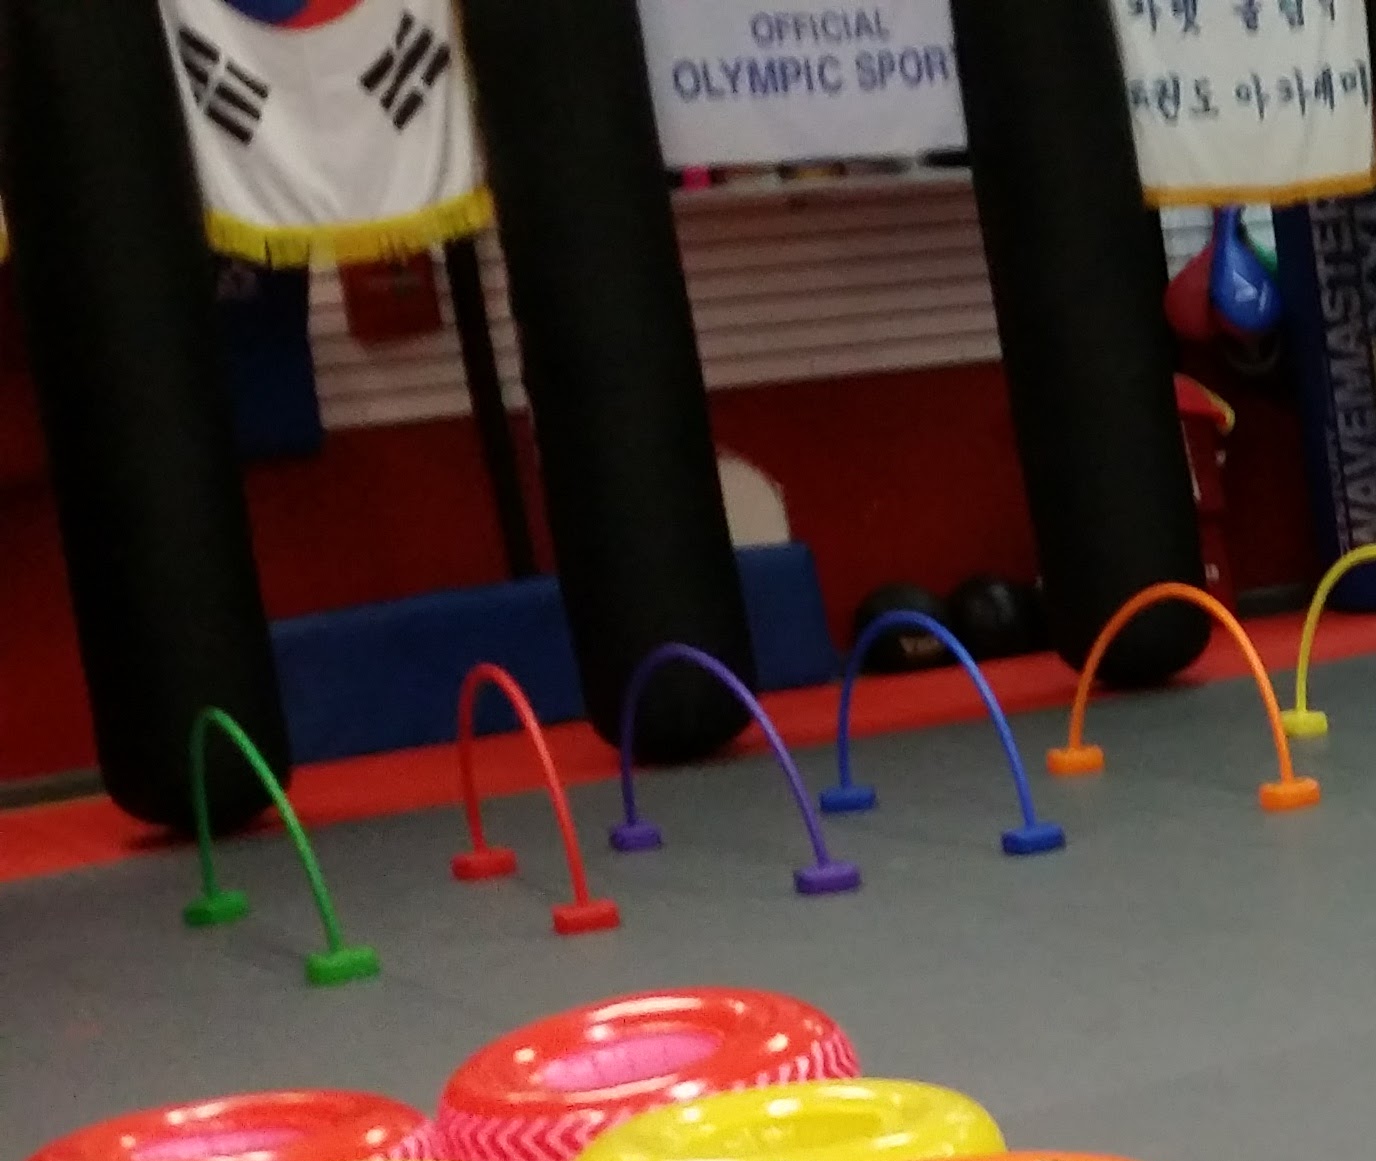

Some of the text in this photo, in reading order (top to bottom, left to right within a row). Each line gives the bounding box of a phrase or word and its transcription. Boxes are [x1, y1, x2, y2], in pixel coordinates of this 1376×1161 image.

[750, 8, 891, 47] OFFICIAL
[673, 45, 951, 102] OLYMPIC SPOR
